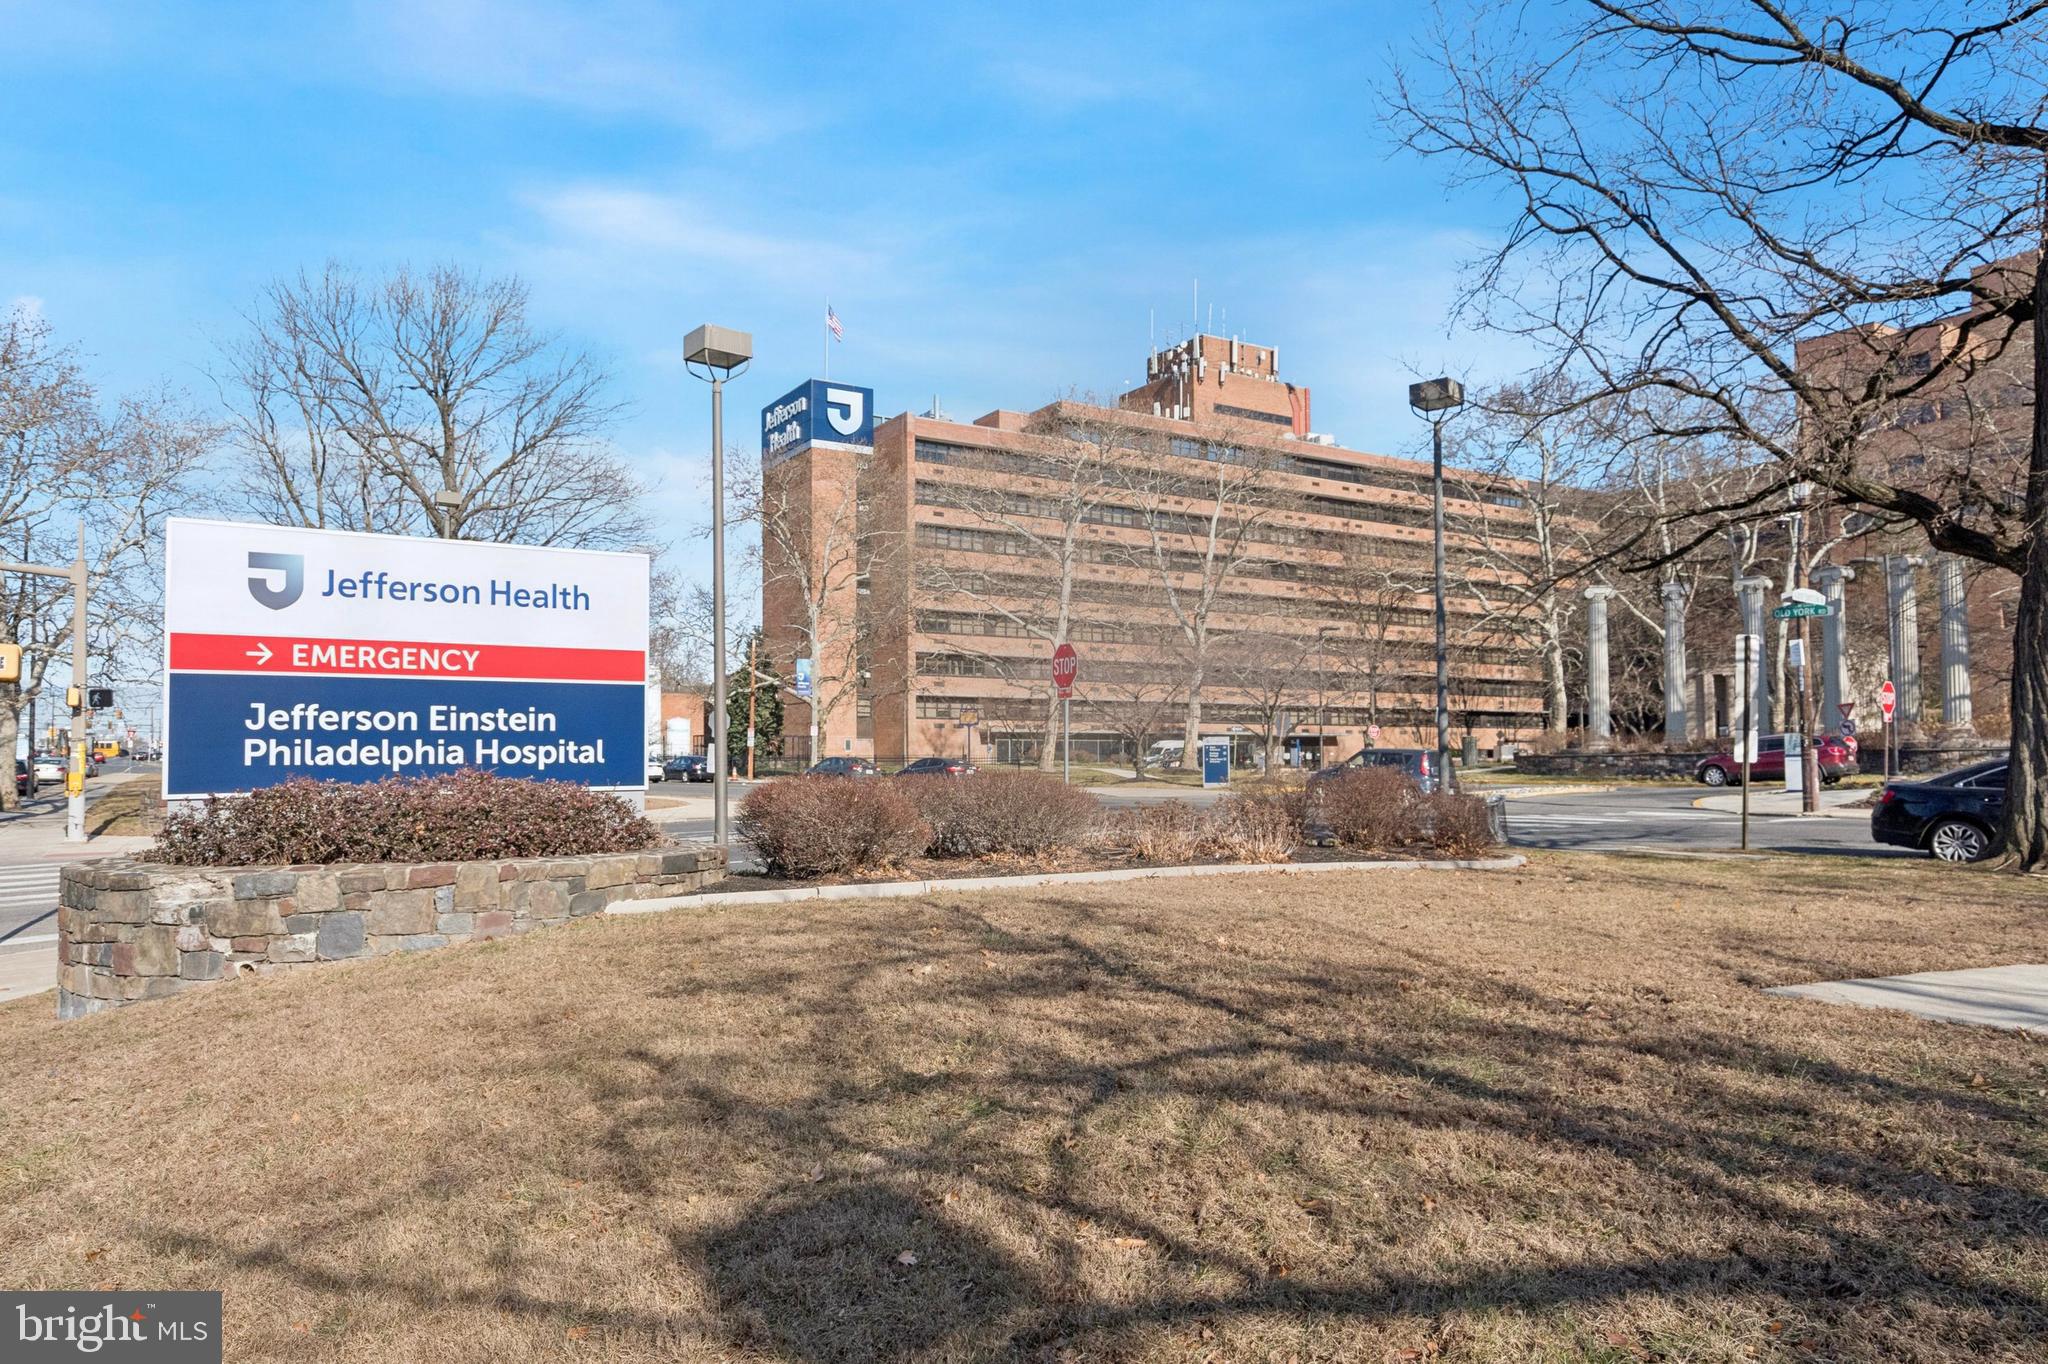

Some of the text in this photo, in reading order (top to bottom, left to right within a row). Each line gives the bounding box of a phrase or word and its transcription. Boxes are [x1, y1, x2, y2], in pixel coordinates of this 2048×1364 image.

[765, 396, 807, 432] Jefferson
[769, 421, 800, 452] Health
[322, 569, 591, 611] Jefferson Health
[1774, 609, 1791, 618] OLD
[1792, 607, 1816, 616] YORK
[292, 643, 480, 672] EMERGENCY
[1053, 656, 1076, 676] STOP
[244, 702, 557, 733] Jefferson Einstein
[243, 738, 605, 771] Philadelphia Hospital
